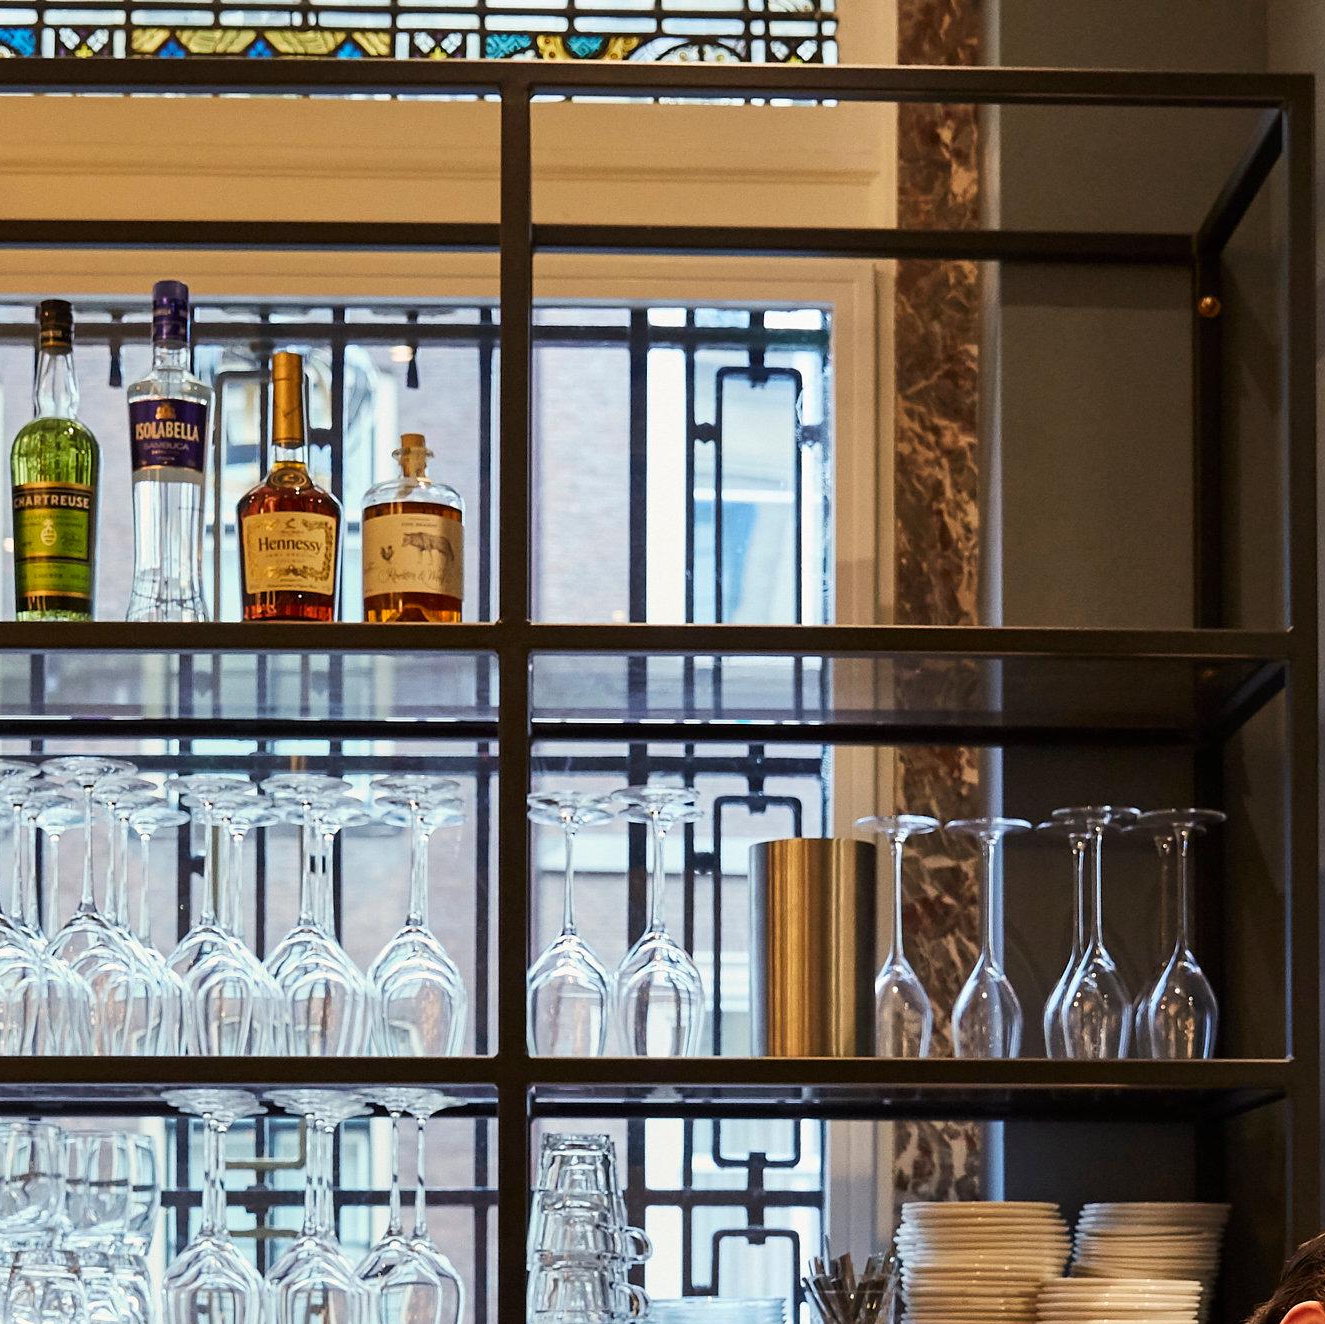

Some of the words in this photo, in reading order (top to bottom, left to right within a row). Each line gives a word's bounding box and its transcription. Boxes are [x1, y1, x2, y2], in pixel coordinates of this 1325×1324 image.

[135, 420, 200, 443] ISOLABELLA
[13, 494, 90, 509] CHARTREUSE
[258, 537, 322, 556] Hennessy
